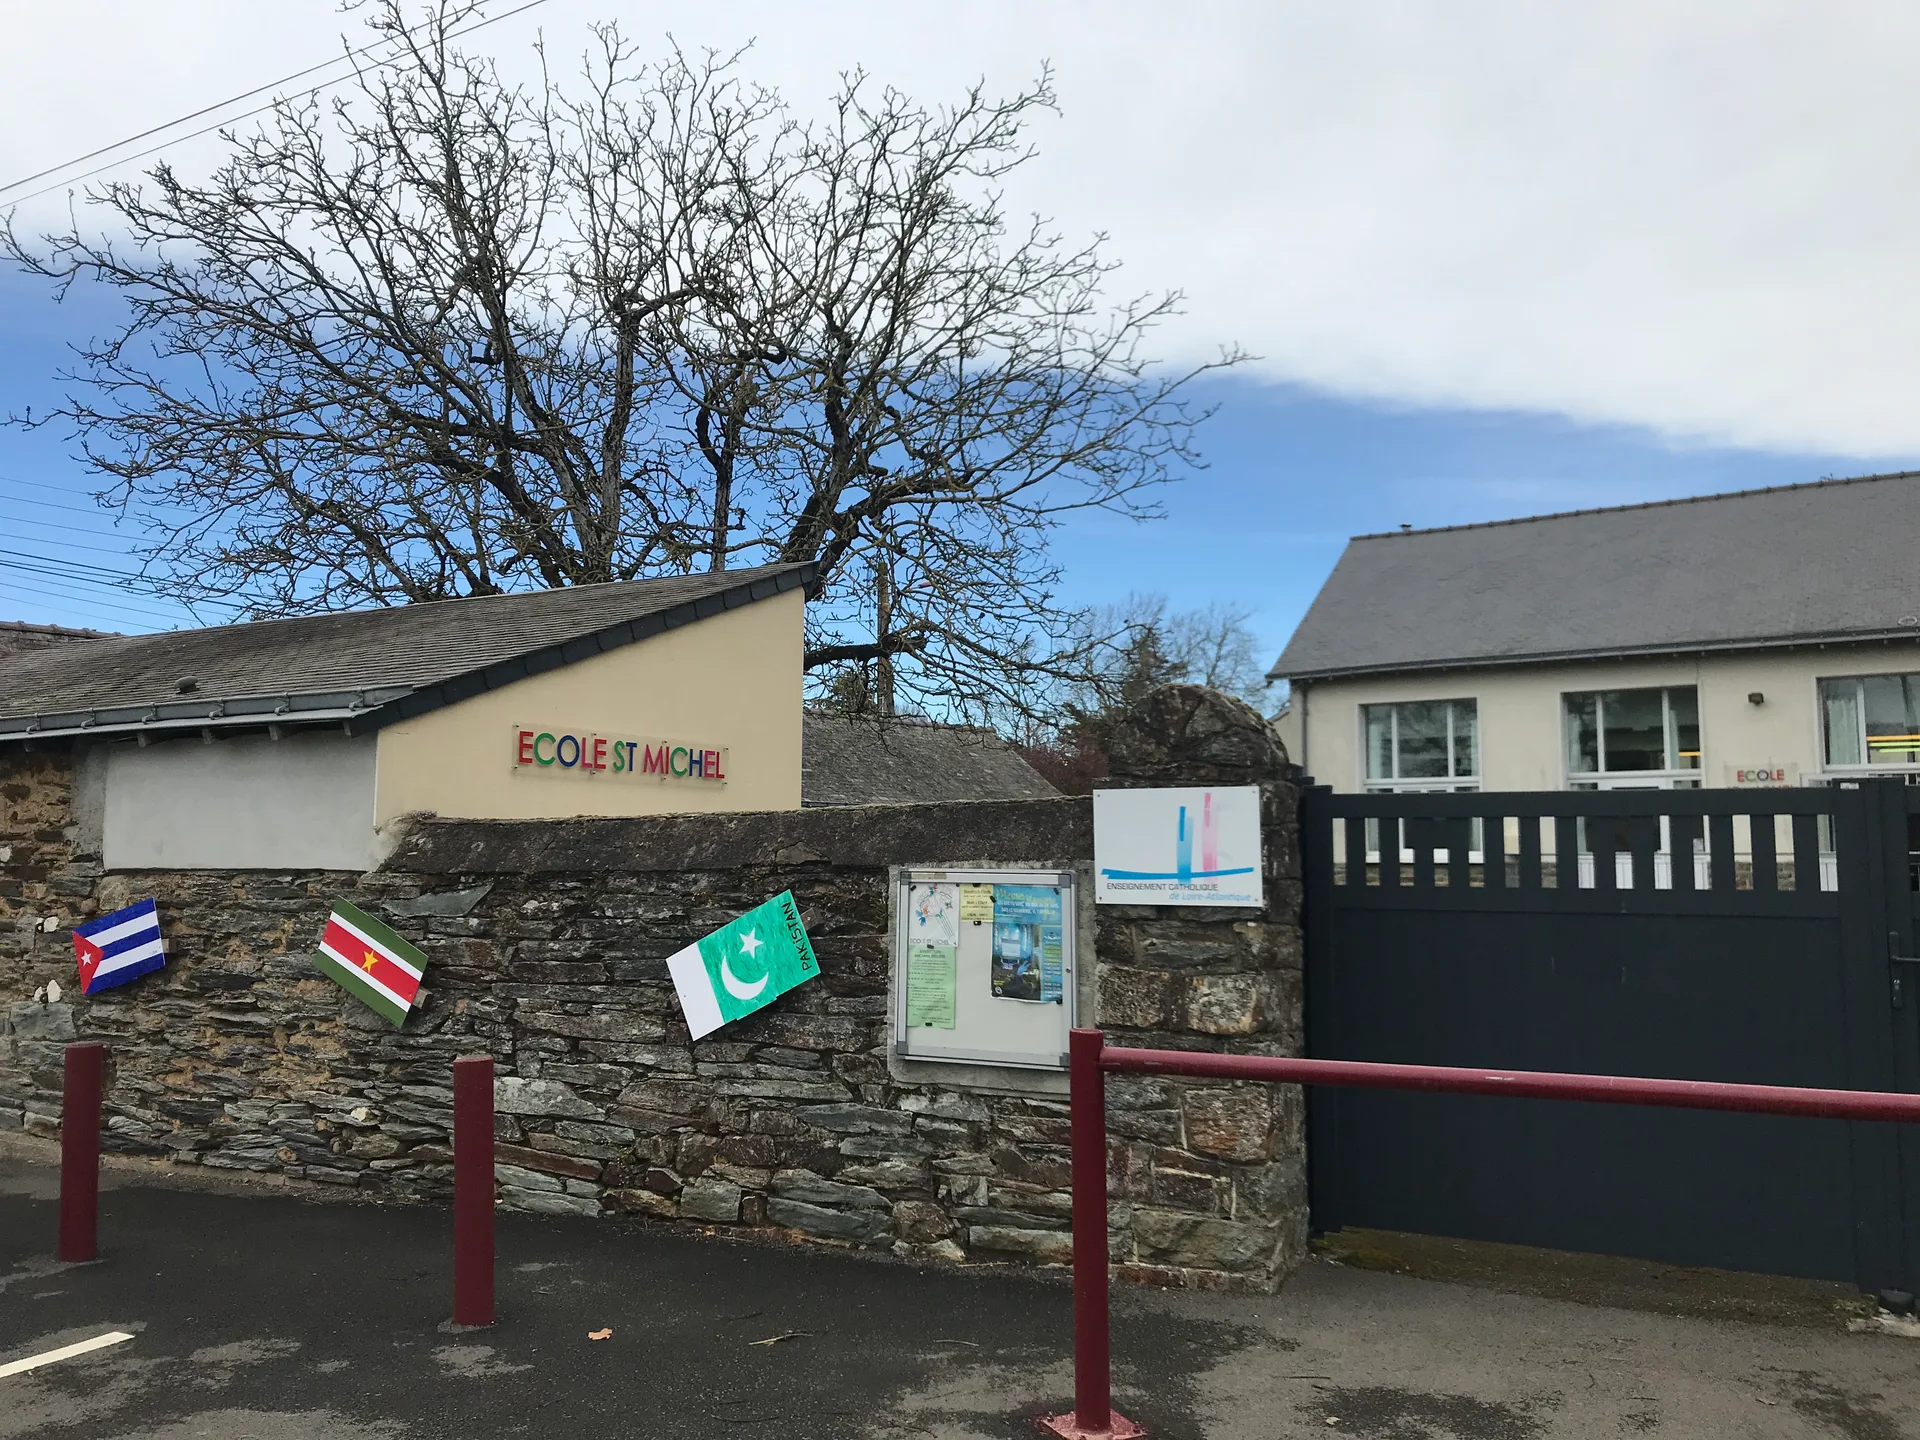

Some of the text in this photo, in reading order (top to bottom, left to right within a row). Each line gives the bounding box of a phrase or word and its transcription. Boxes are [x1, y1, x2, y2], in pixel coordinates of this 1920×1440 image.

[518, 731, 725, 779] ECOLE ST MICHEL
[1737, 769, 1785, 783] ECOLE
[1107, 883, 1219, 892] ENSEIGNEMENT CATHOLIQUE
